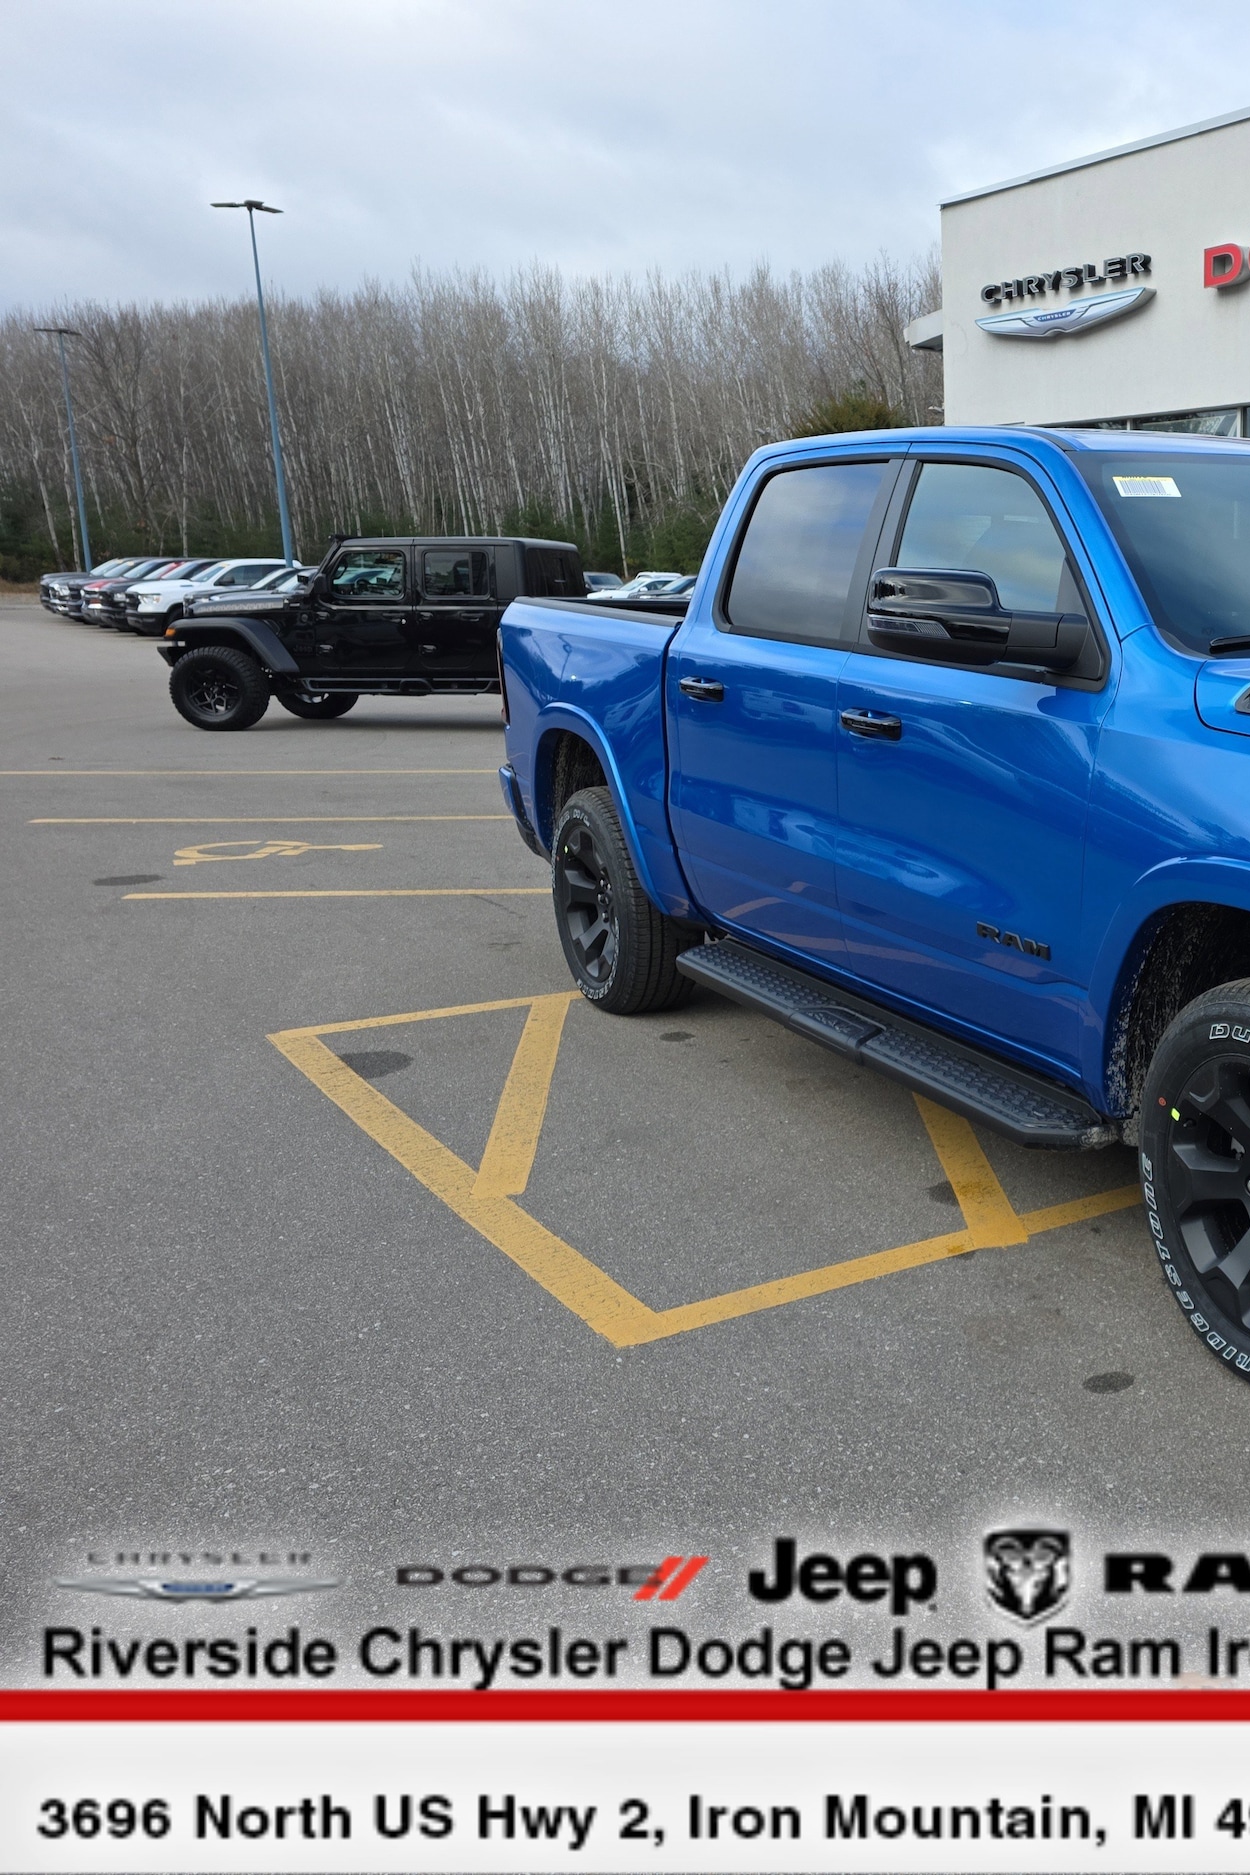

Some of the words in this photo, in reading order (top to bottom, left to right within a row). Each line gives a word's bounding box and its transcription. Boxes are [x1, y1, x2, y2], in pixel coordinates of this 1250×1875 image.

[981, 252, 1152, 305] CHRYSLER
[1036, 310, 1072, 322] CHRYSLER
[976, 920, 1052, 962] RAM
